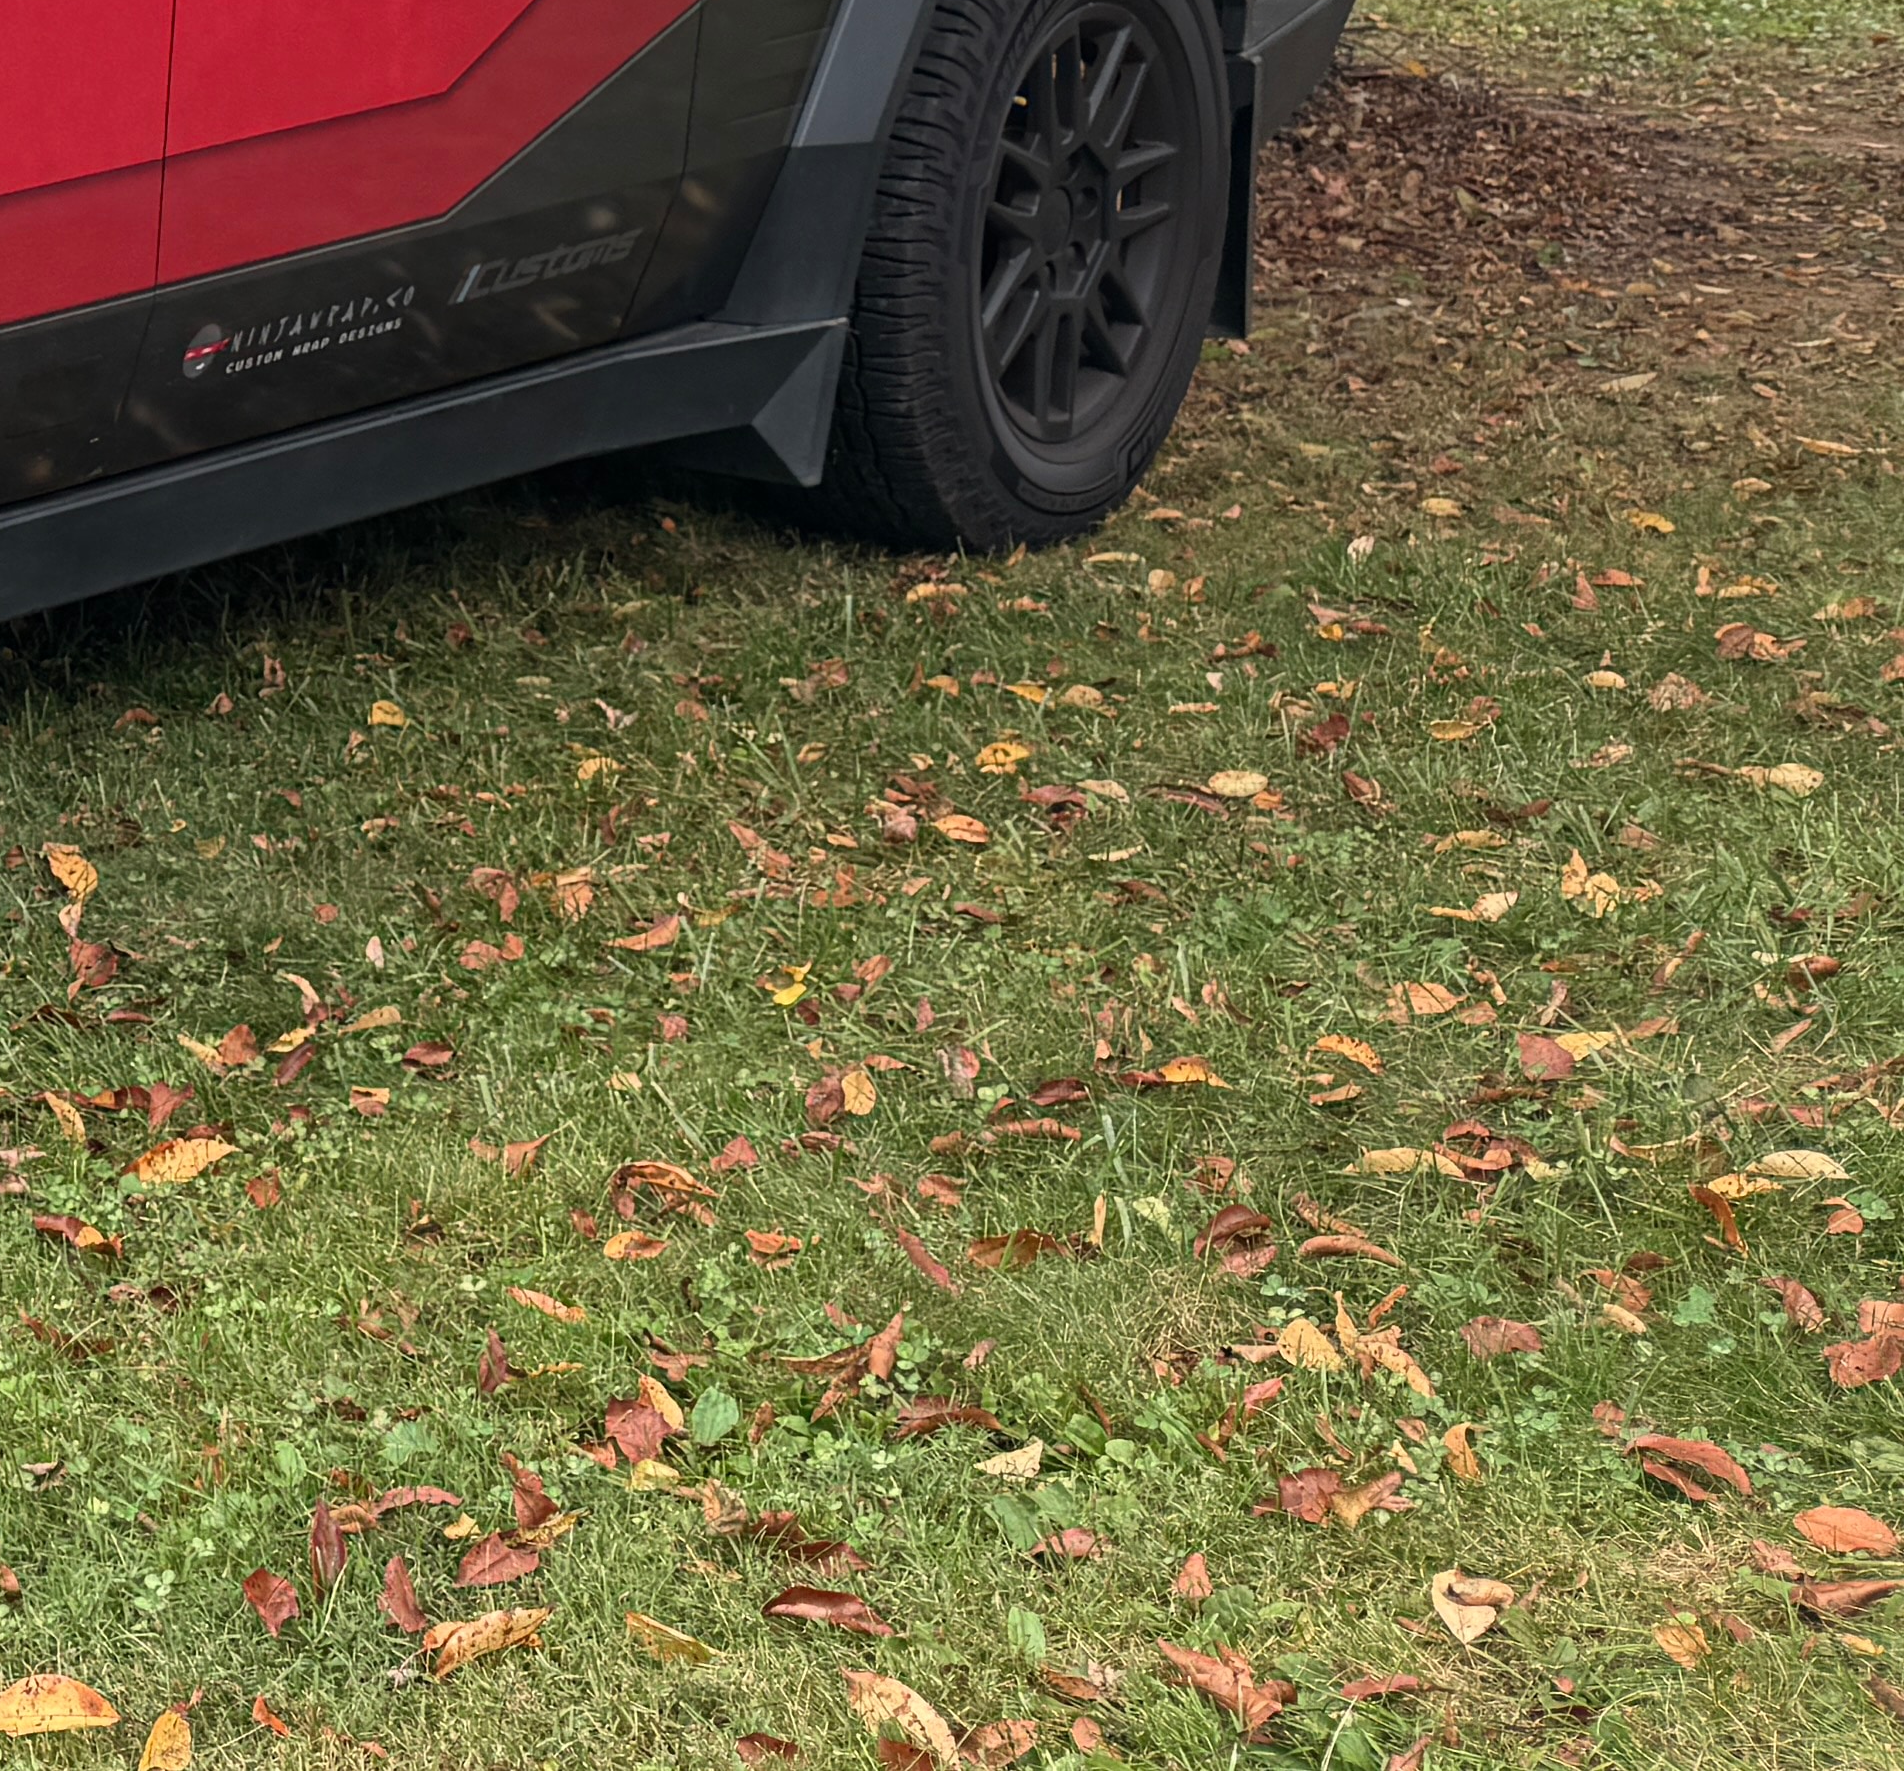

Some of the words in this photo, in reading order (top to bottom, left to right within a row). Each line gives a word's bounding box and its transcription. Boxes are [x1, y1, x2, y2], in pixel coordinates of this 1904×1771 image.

[225, 348, 284, 374] CUSTOM
[291, 337, 330, 357] WRAP
[338, 317, 403, 345] DESIGNS
